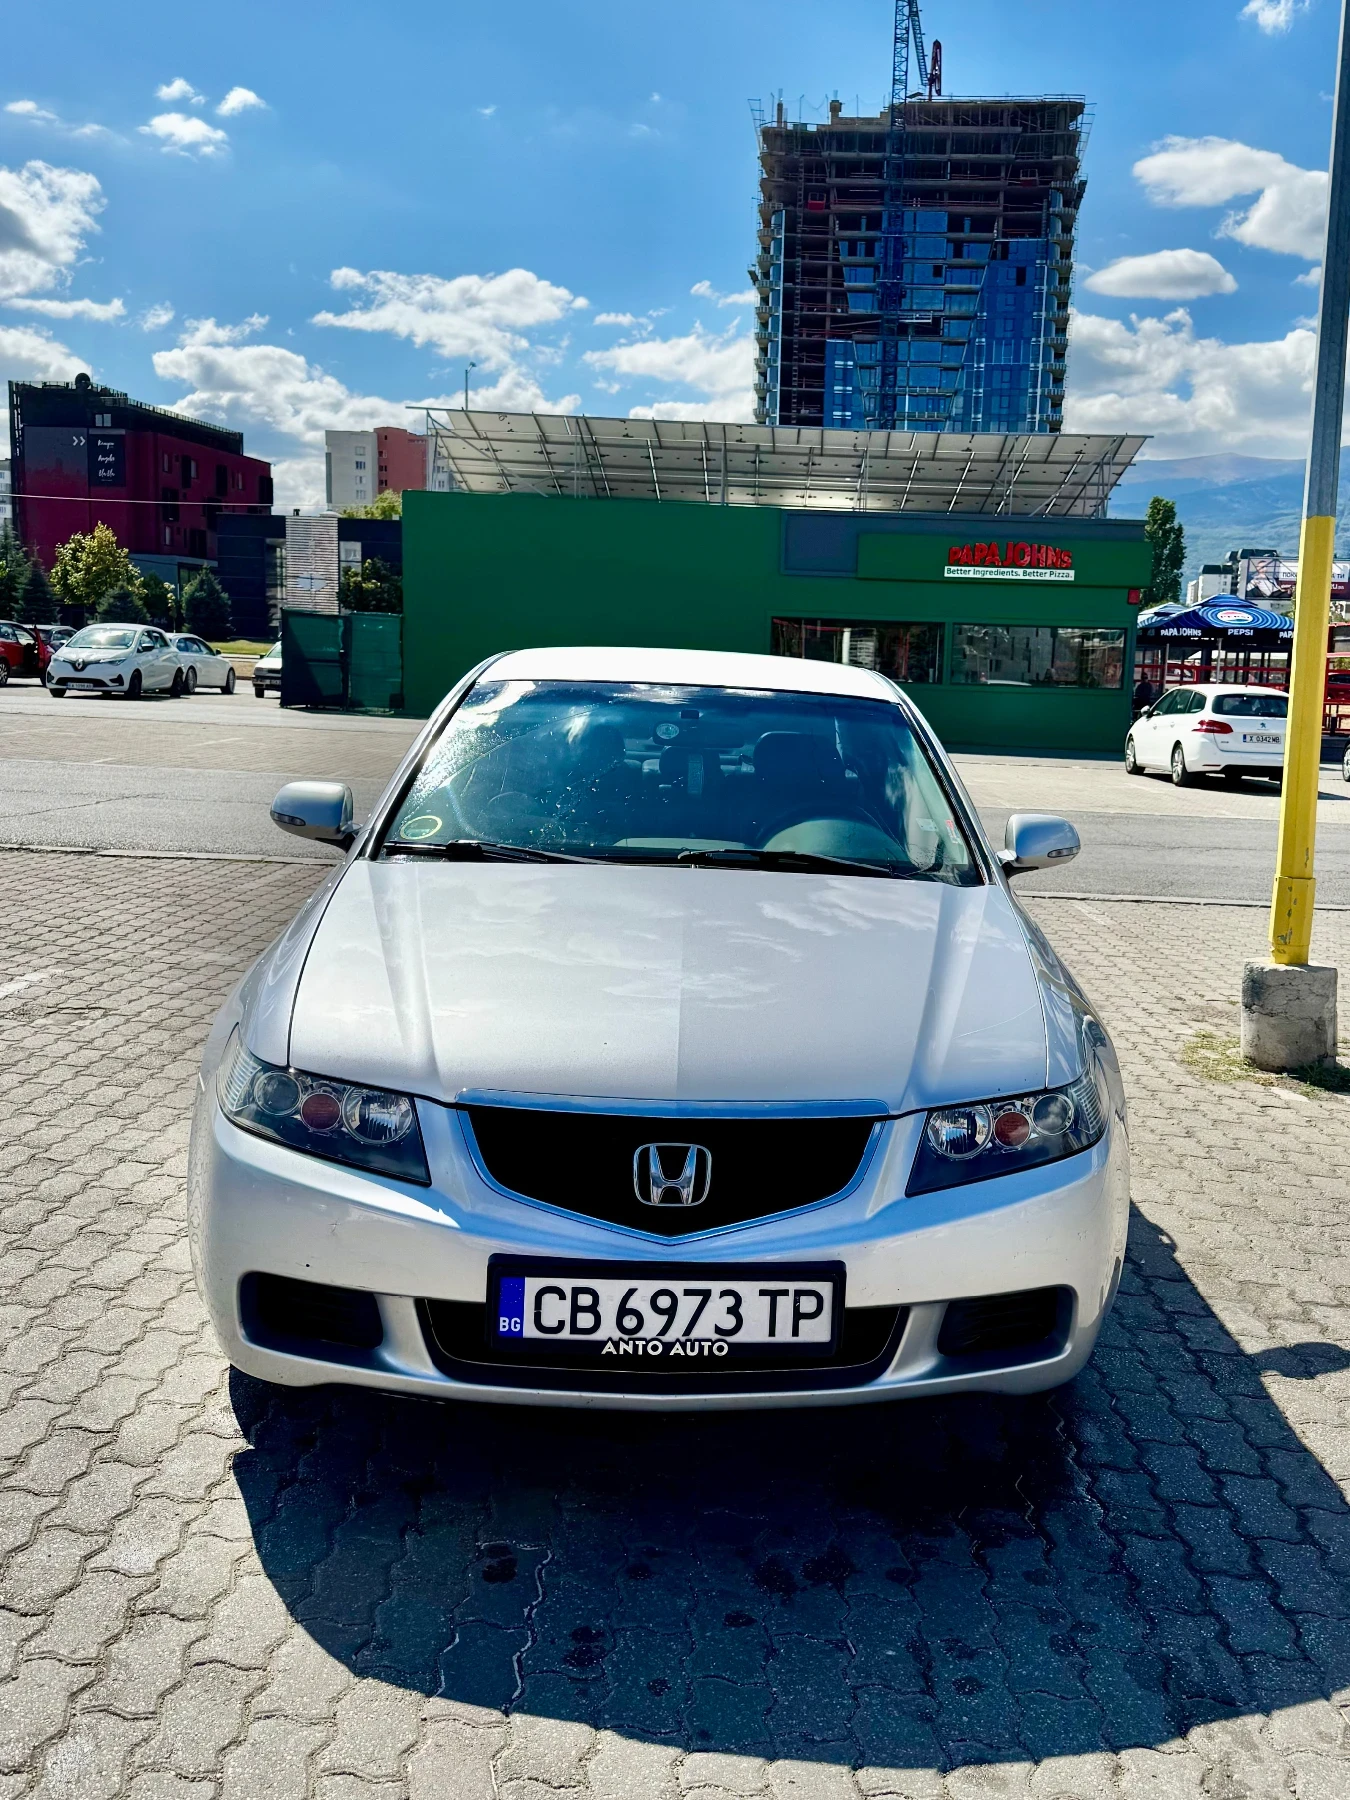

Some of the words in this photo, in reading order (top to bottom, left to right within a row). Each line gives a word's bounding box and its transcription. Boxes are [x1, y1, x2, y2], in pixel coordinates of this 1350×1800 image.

[946, 568, 972, 576] Better
[973, 568, 1021, 578] Ingredients.
[1022, 569, 1048, 578] Better
[1049, 571, 1073, 579] Pizza.
[1227, 628, 1254, 636] PEPSI
[533, 1285, 602, 1336] CB
[615, 1287, 744, 1337] 6973
[758, 1288, 825, 1338] TP
[499, 1317, 521, 1332] BG
[600, 1339, 663, 1356] ANTO
[669, 1340, 730, 1357] AUTO
